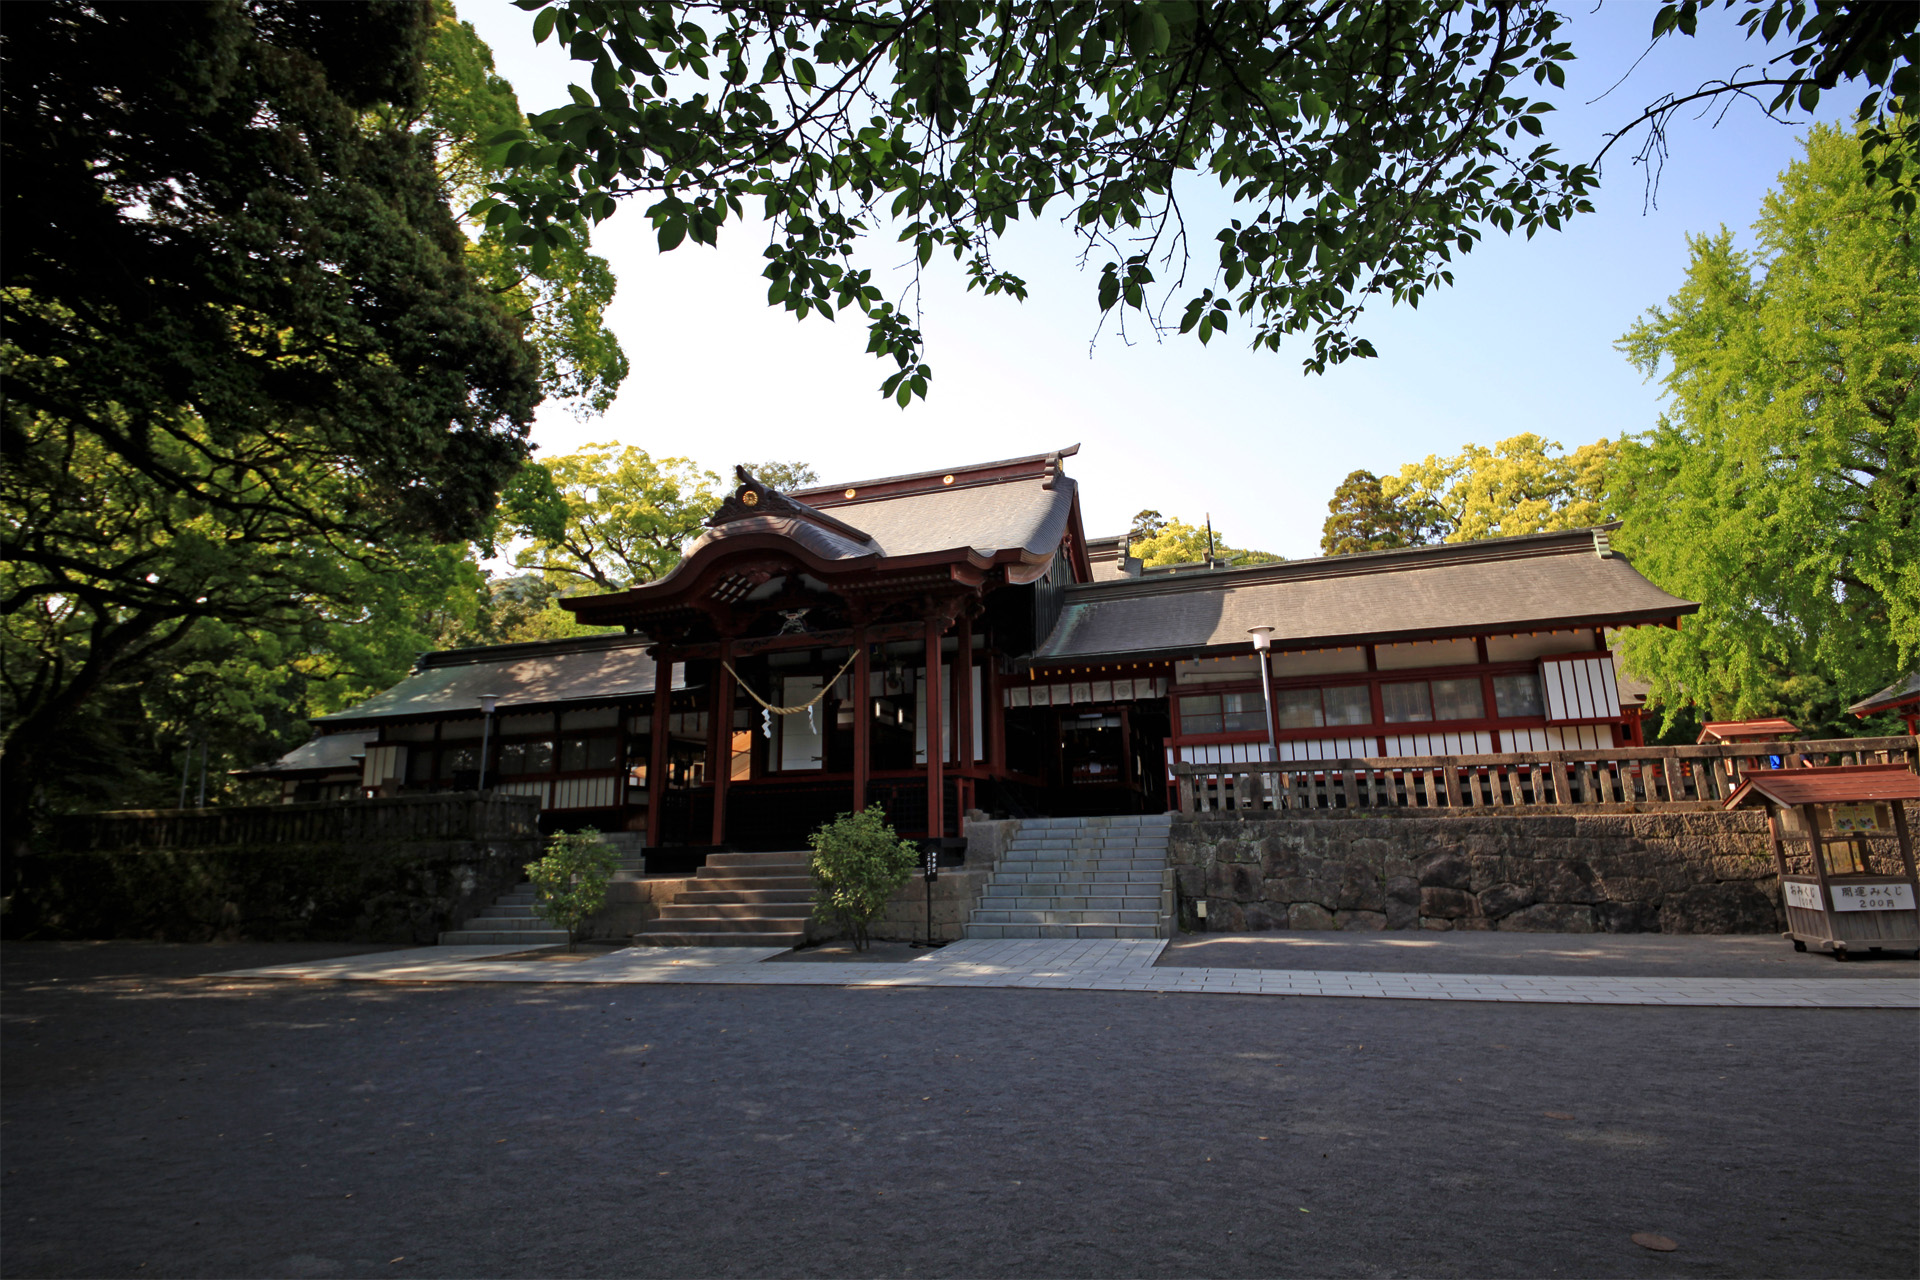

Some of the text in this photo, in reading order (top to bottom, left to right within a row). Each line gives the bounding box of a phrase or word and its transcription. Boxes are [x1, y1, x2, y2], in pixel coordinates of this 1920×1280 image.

[1790, 884, 1815, 898] おみくじ
[1841, 886, 1902, 897] 開運みくじ
[1859, 899, 1895, 908] 200円
